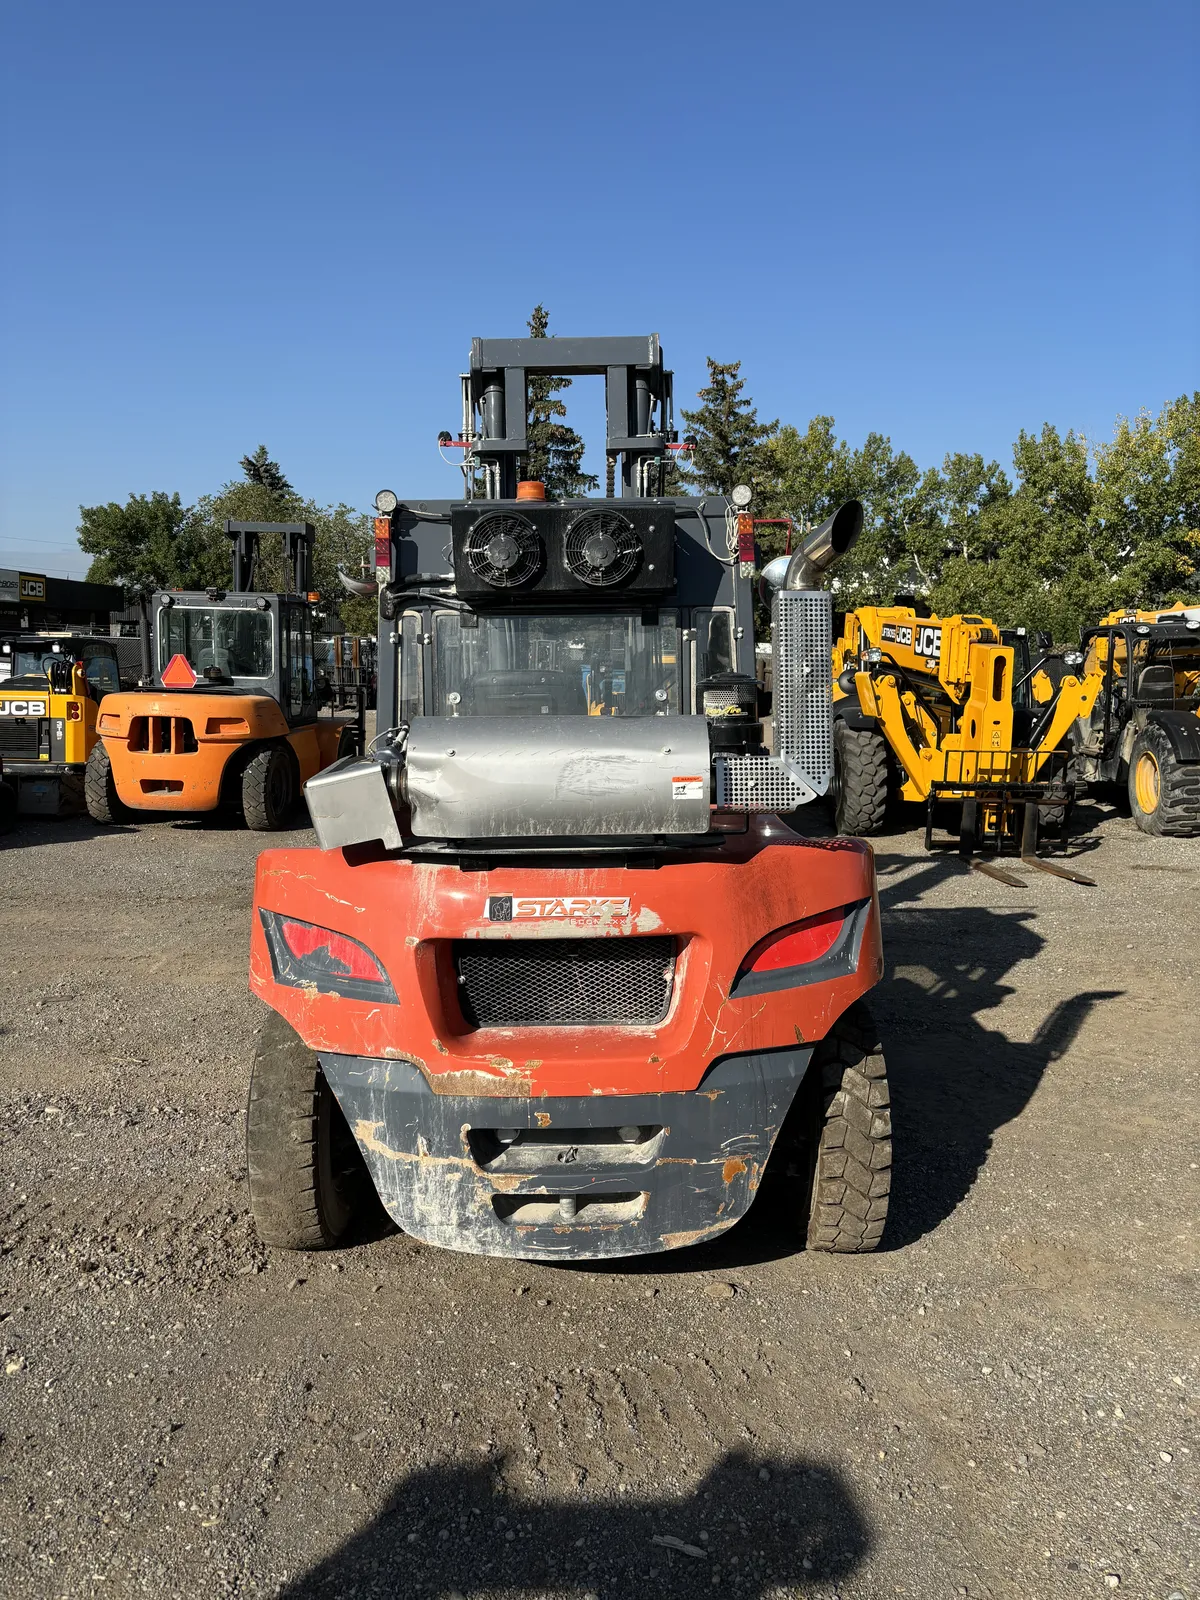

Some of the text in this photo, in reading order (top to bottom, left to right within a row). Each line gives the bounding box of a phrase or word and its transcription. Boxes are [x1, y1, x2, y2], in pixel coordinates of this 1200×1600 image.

[22, 581, 44, 596] JCB
[895, 626, 912, 645] JCB
[0, 701, 45, 715] JCB
